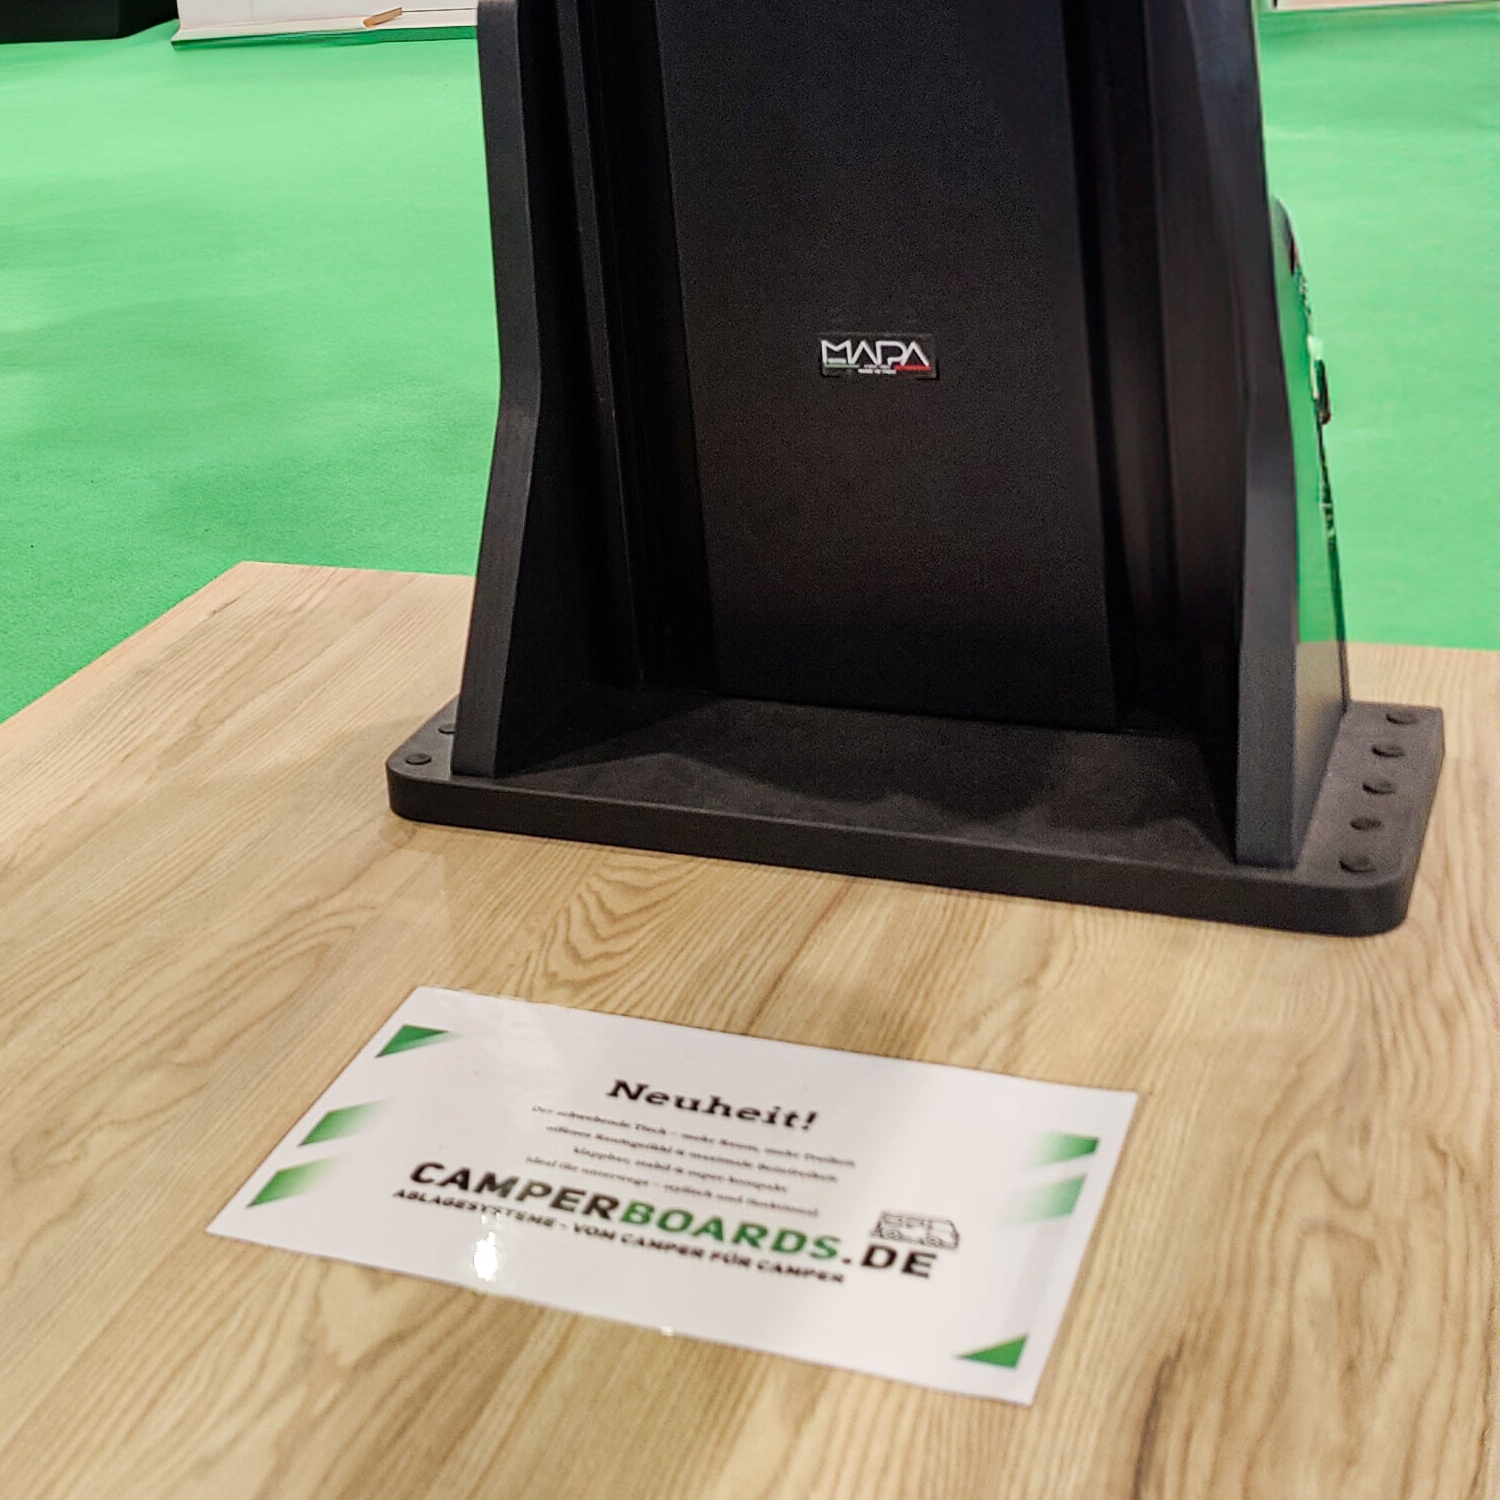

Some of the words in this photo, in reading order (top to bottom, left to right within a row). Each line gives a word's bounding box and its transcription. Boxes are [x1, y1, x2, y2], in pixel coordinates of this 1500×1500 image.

[820, 339, 931, 367] MAPA
[606, 1079, 818, 1131] Neuheit!
[392, 1188, 557, 1229] ABLAGESYSTEME
[573, 1222, 616, 1241] VOM
[621, 1232, 704, 1259] CAMPER
[709, 1249, 751, 1269] FÜR
[757, 1258, 845, 1285] CAMPER
[410, 1161, 938, 1279] CAMPERBOARDS.DE
